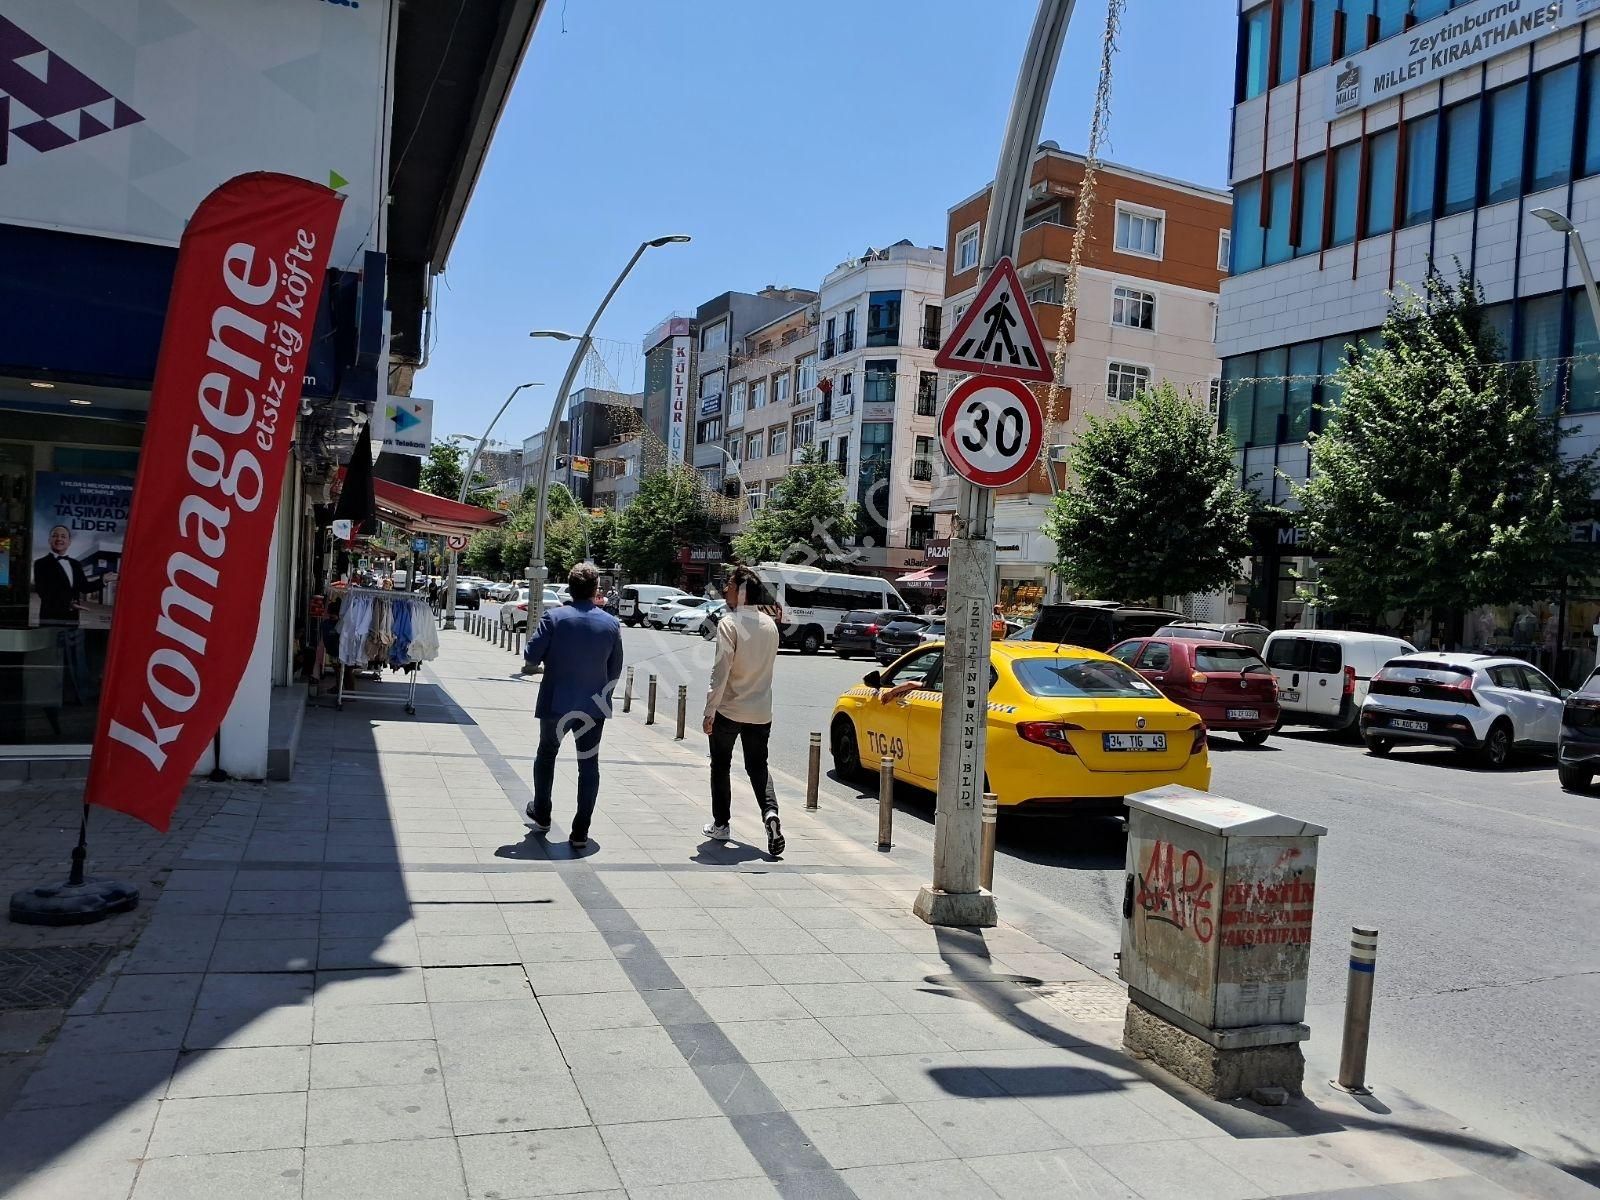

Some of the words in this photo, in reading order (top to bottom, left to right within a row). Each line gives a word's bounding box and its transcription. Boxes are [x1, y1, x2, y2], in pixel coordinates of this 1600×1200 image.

[1408, 0, 1521, 56] Zeytinburnu
[276, 228, 316, 319] köfte
[270, 320, 302, 374] çiğ
[673, 346, 686, 422] KÜLTÜR
[256, 377, 285, 451] etsiz
[962, 402, 1023, 457] 30
[60, 494, 130, 508] NUMARA
[108, 242, 278, 772] komagene
[867, 731, 888, 755] TIG
[890, 736, 904, 760] 49
[1110, 735, 1121, 747] 34
[1130, 735, 1143, 747] TIG
[1152, 735, 1164, 747] 49
